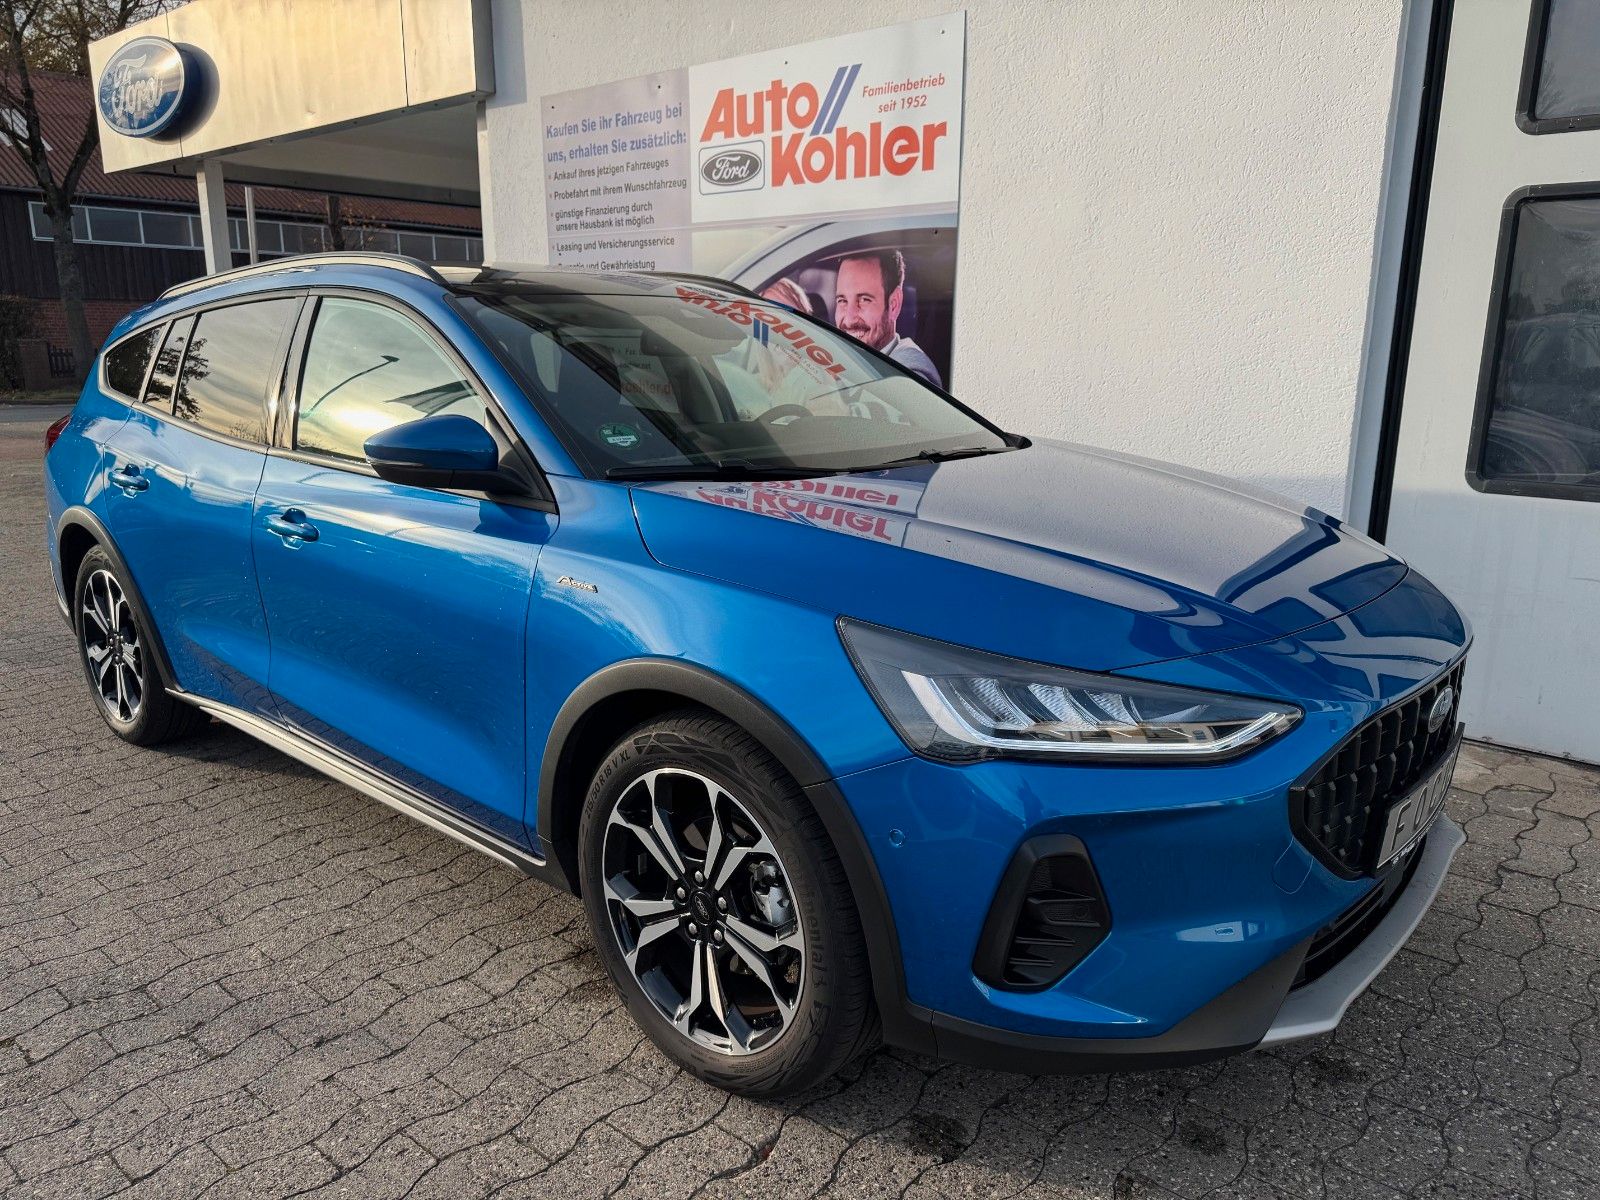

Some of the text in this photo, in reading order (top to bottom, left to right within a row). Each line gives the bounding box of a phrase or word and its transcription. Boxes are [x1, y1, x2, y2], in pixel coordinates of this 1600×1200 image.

[862, 73, 946, 98] Familienbetrieb
[700, 79, 819, 142] Auto
[878, 95, 928, 113] seit 1952
[546, 102, 682, 139] Kaufen Sie ihr Fahrzeug bei
[547, 130, 687, 163] uns, erhalten Sie zusätzlich:
[553, 158, 669, 181] Ankauf ihres jetzigen Fahrzeuges
[712, 155, 749, 181] Ford
[554, 177, 687, 200] Probefahrt mit ihrem Wunschfahrzeug
[555, 201, 653, 221] günstige Finanzierung durch
[556, 215, 655, 232] unsere Hausbank ist möglich
[556, 236, 675, 253] Leasing und Versicherungsservice
[600, 259, 656, 270] Gewährleistung
